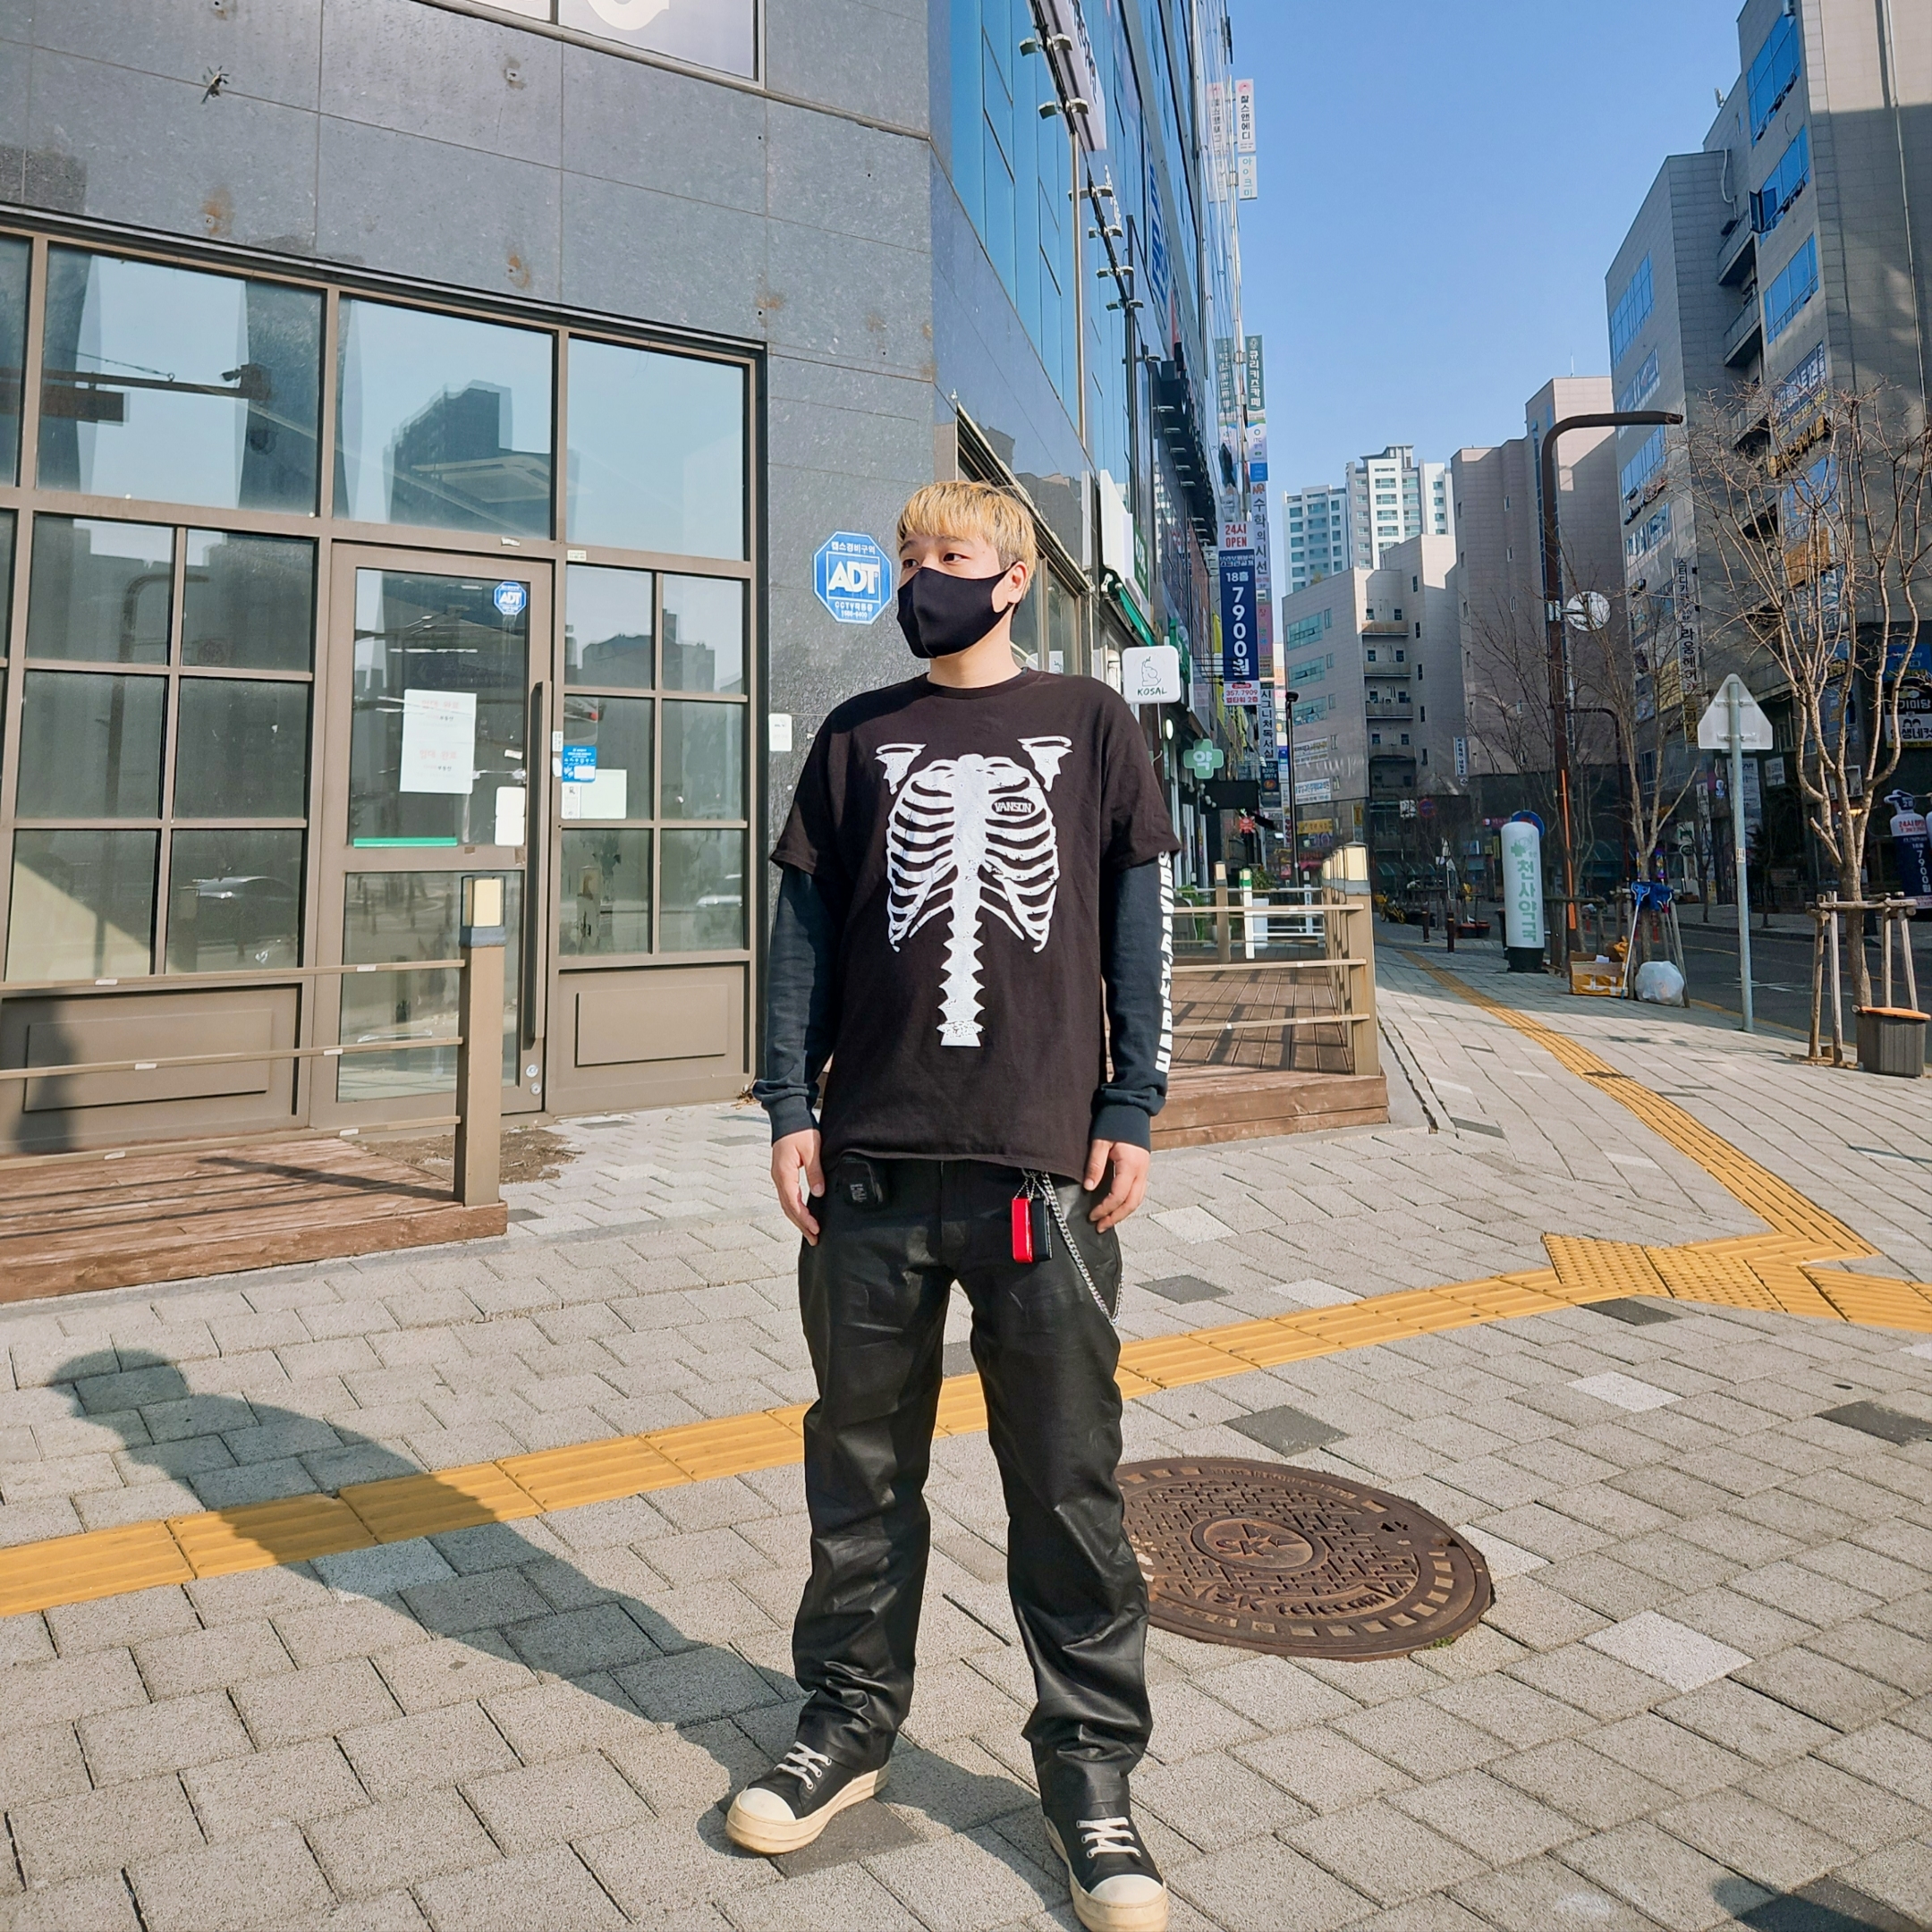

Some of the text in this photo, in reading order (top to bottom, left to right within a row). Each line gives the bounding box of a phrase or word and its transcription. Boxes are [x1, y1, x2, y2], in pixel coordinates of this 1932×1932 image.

[1225, 523, 1247, 535] 24시
[1225, 537, 1247, 548] OPEN
[828, 561, 880, 595] ADT
[498, 590, 522, 606] ADT
[1137, 686, 1168, 697] KOSAL
[1261, 689, 1275, 759] 시그니처독서실
[1192, 750, 1213, 771] 약
[994, 801, 1032, 814] VANSON
[1517, 859, 1538, 943] 천사약국
[1216, 1538, 1274, 1558] SK
[1213, 1589, 1387, 1617] SK telecom
